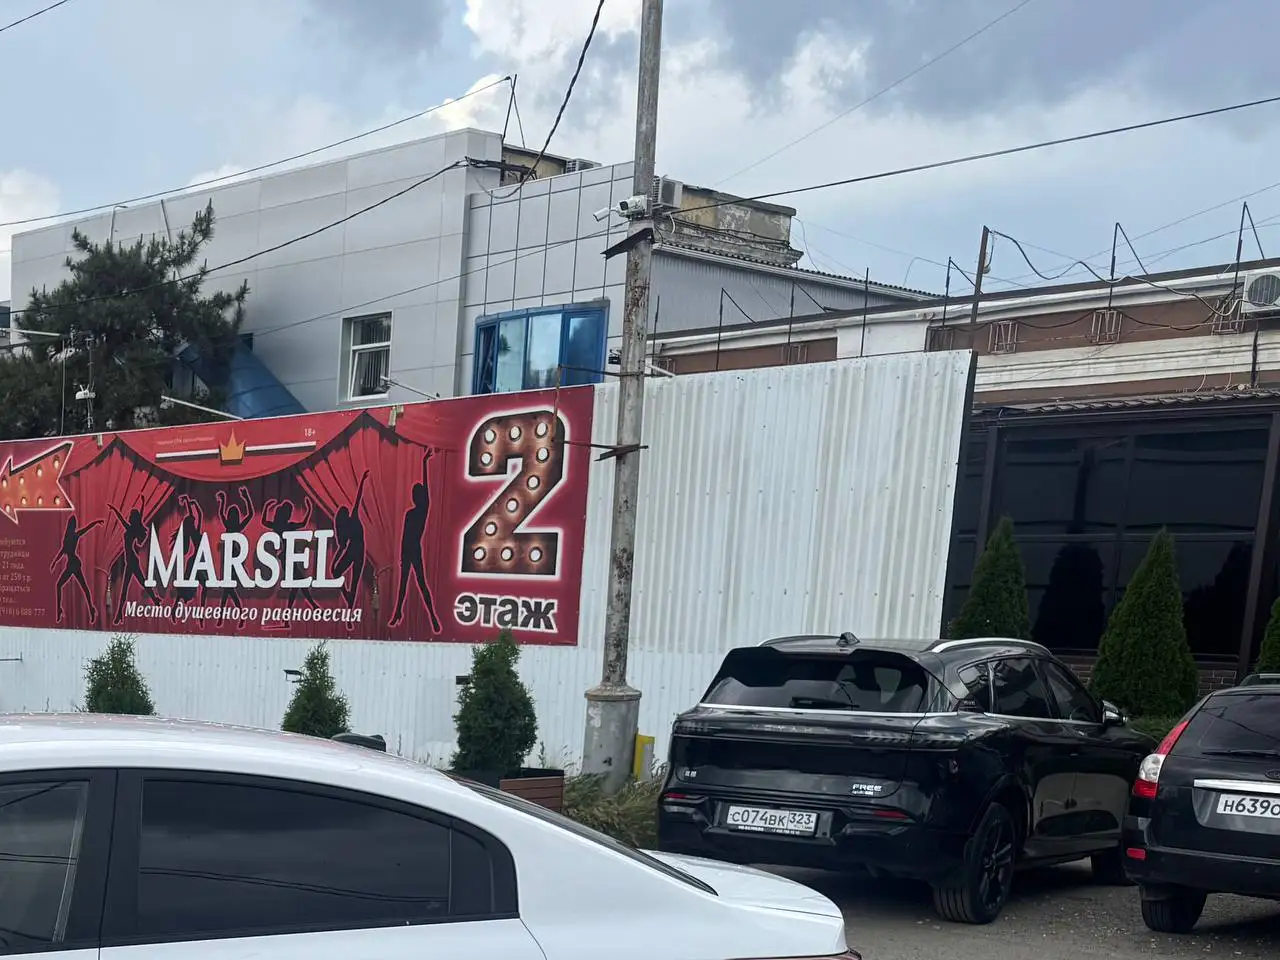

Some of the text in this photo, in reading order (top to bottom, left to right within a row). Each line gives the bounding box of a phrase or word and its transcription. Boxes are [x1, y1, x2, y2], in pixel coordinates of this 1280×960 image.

[304, 428, 316, 437] 18+
[457, 405, 569, 581] 2
[144, 521, 345, 589] MARSEL
[2, 561, 9, 569] 21
[124, 600, 362, 624] Место душевного равновесия
[852, 783, 882, 792] FREE
[789, 812, 811, 825] 323
